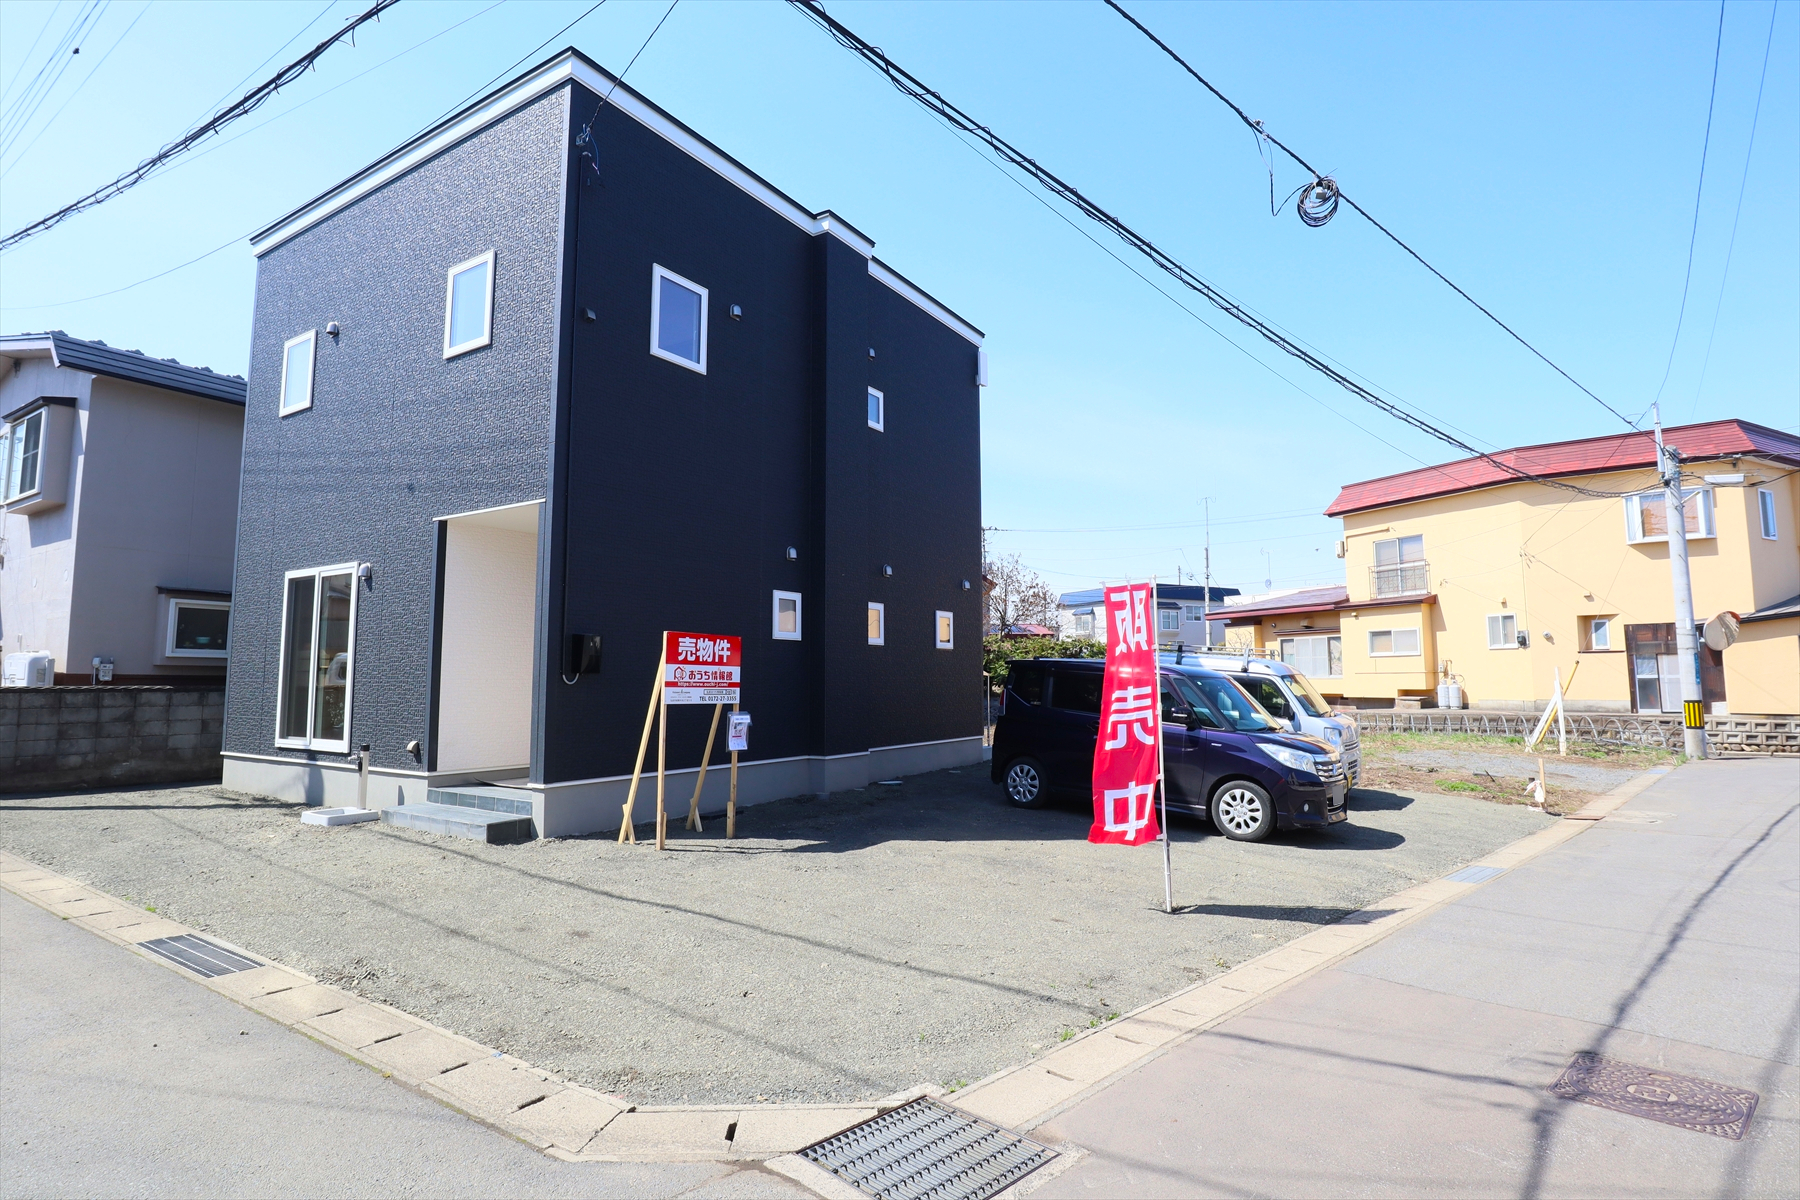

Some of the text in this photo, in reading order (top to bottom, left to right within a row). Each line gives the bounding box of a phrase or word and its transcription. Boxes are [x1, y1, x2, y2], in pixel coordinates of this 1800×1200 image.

[678, 637, 731, 663] 売物件
[689, 670, 733, 681] おうち情報館
